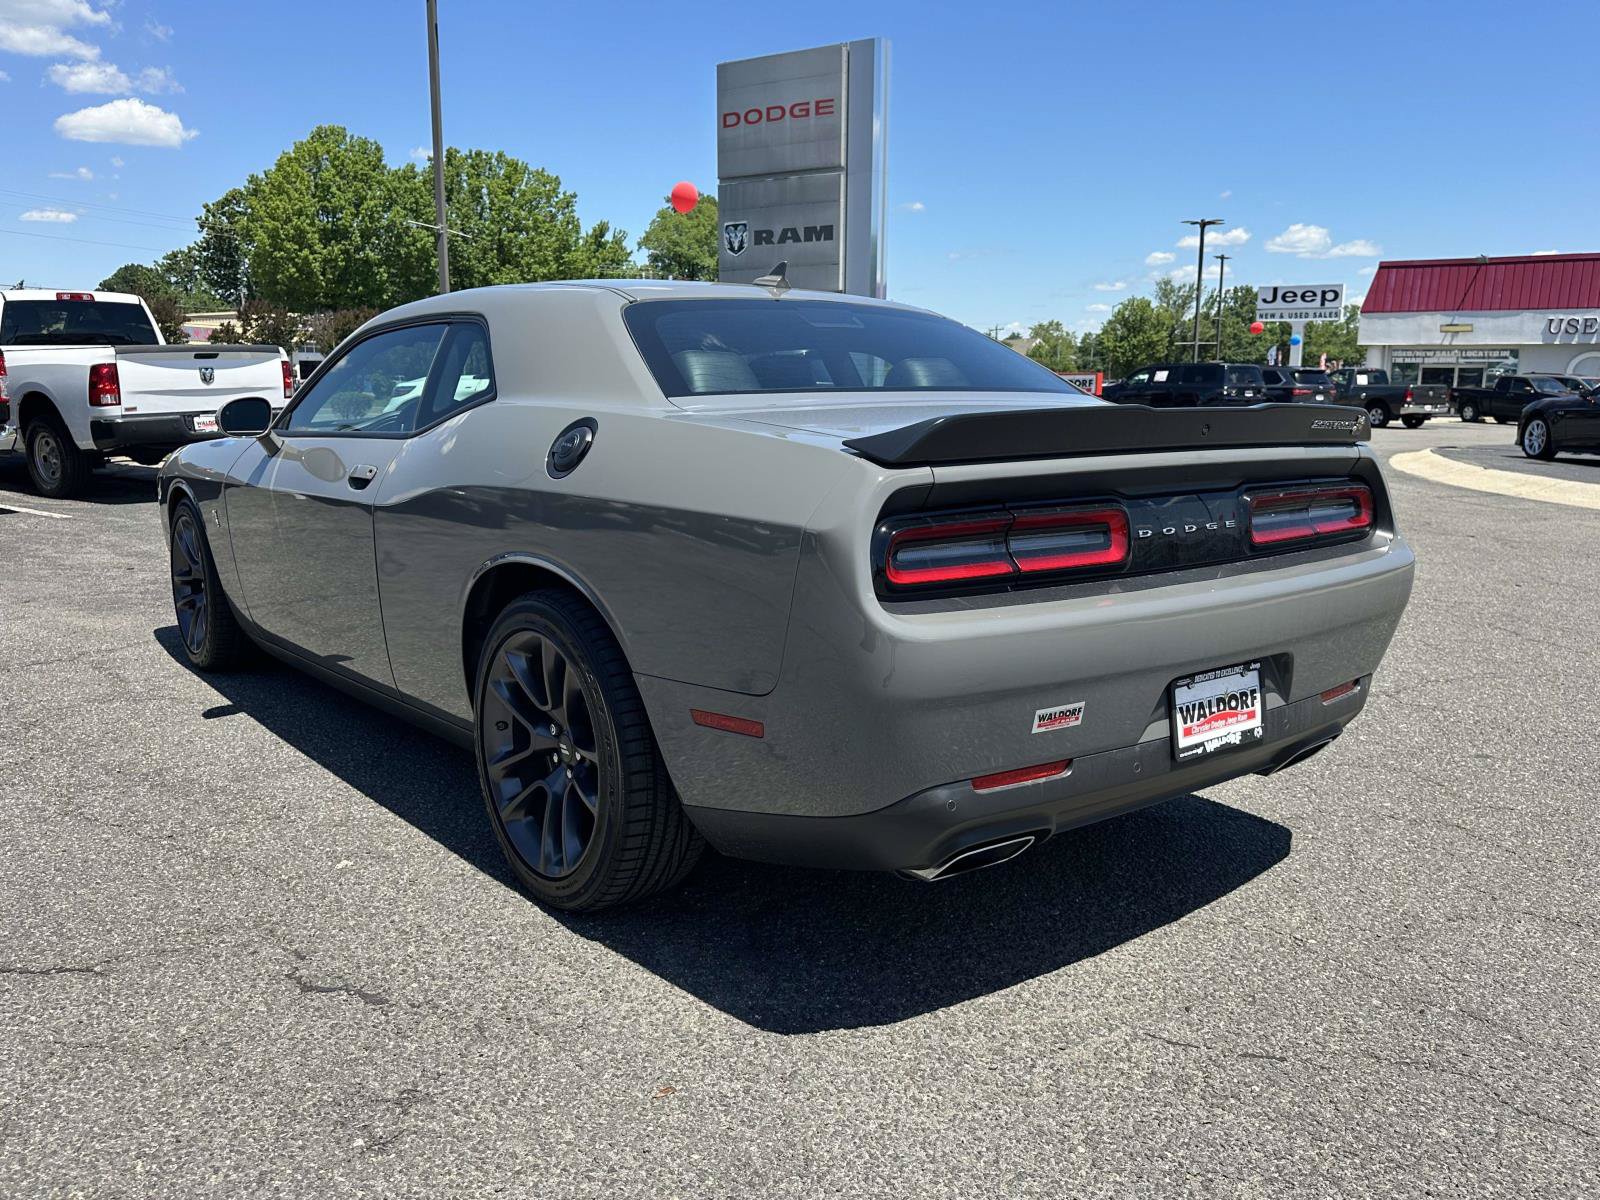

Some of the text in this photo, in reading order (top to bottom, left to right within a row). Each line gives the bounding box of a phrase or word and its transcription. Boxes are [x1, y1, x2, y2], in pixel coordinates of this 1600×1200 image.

[722, 98, 835, 129] DODGE
[754, 225, 834, 246] RAM
[1261, 286, 1339, 307] Jeep
[1259, 312, 1276, 320] NEW
[1313, 311, 1338, 319] SALES
[1138, 520, 1237, 538] DODGE
[1194, 665, 1244, 683] DEDICATED TO EXCELLENCE
[1038, 707, 1082, 723] WALDORF
[1178, 688, 1258, 726] WALDORF
[1204, 731, 1242, 753] WALDORF
